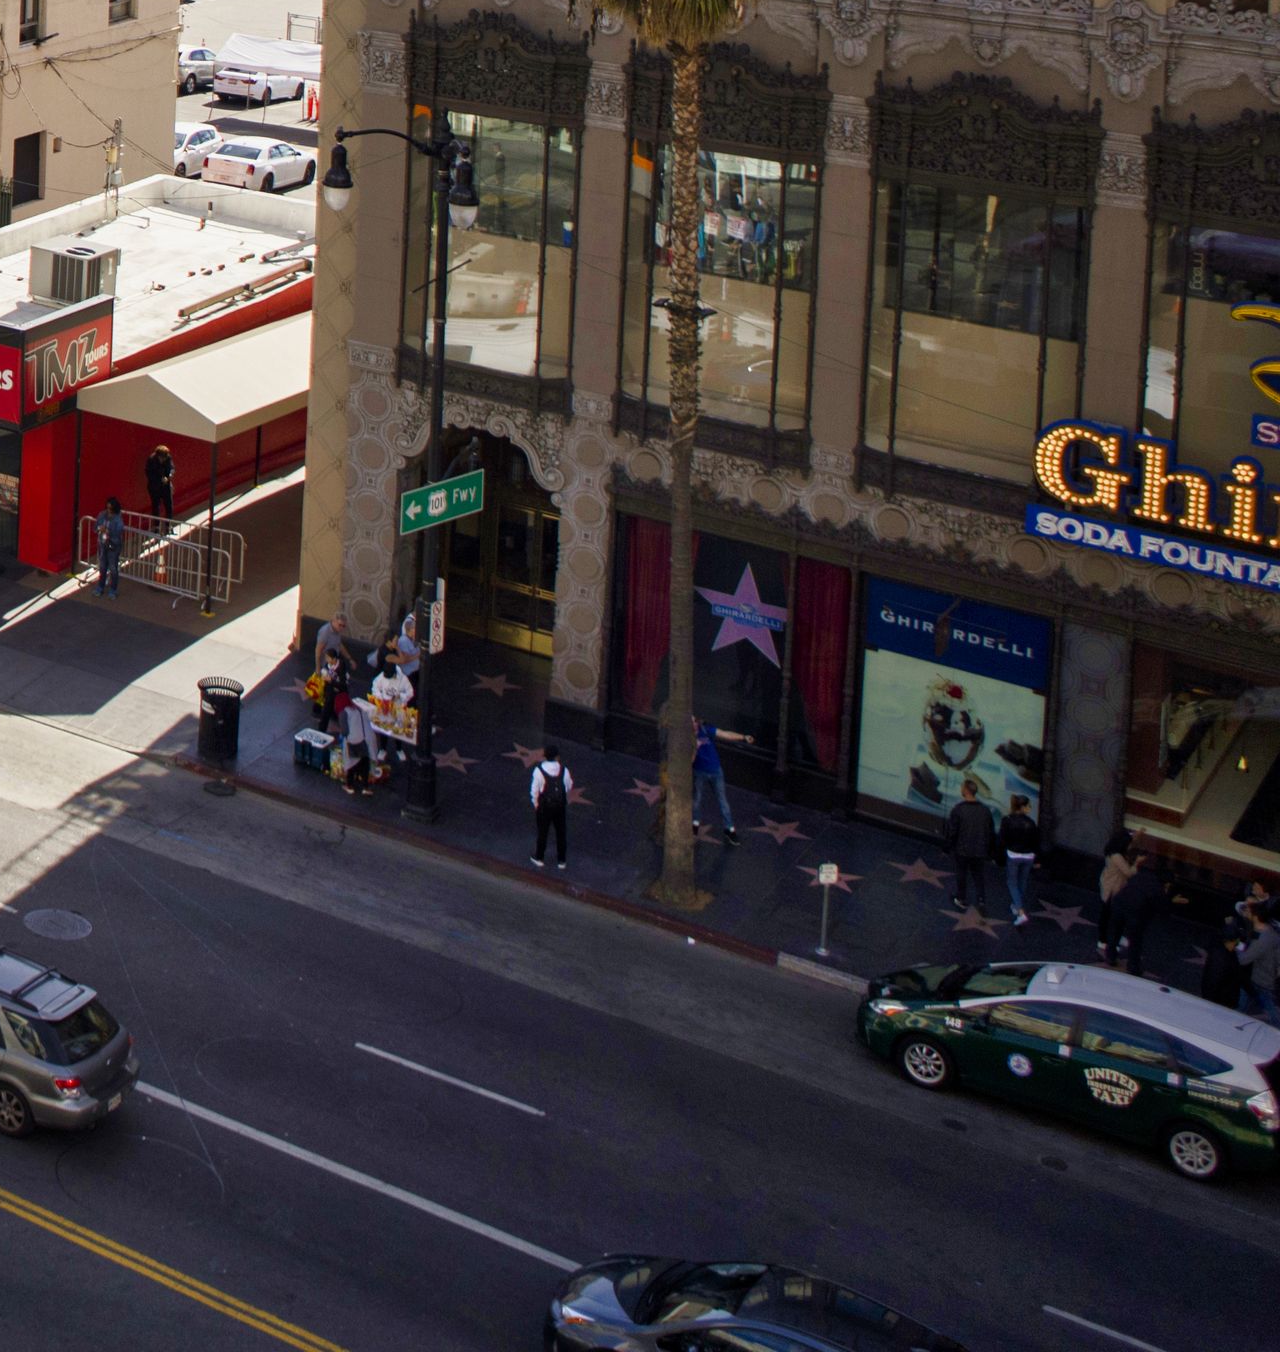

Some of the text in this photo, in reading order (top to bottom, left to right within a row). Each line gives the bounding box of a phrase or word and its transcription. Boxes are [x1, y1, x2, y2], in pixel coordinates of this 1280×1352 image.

[25, 328, 109, 404] TMZ TOURS
[1256, 422, 1280, 444] S
[431, 486, 477, 511] 101 Fwy
[1035, 512, 1134, 555] SODA
[714, 605, 782, 629] GHIRARDELLI
[880, 608, 1035, 659] GHIRRDELLI
[1084, 1067, 1139, 1093] UNITED
[1091, 1086, 1132, 1106] TAXI
